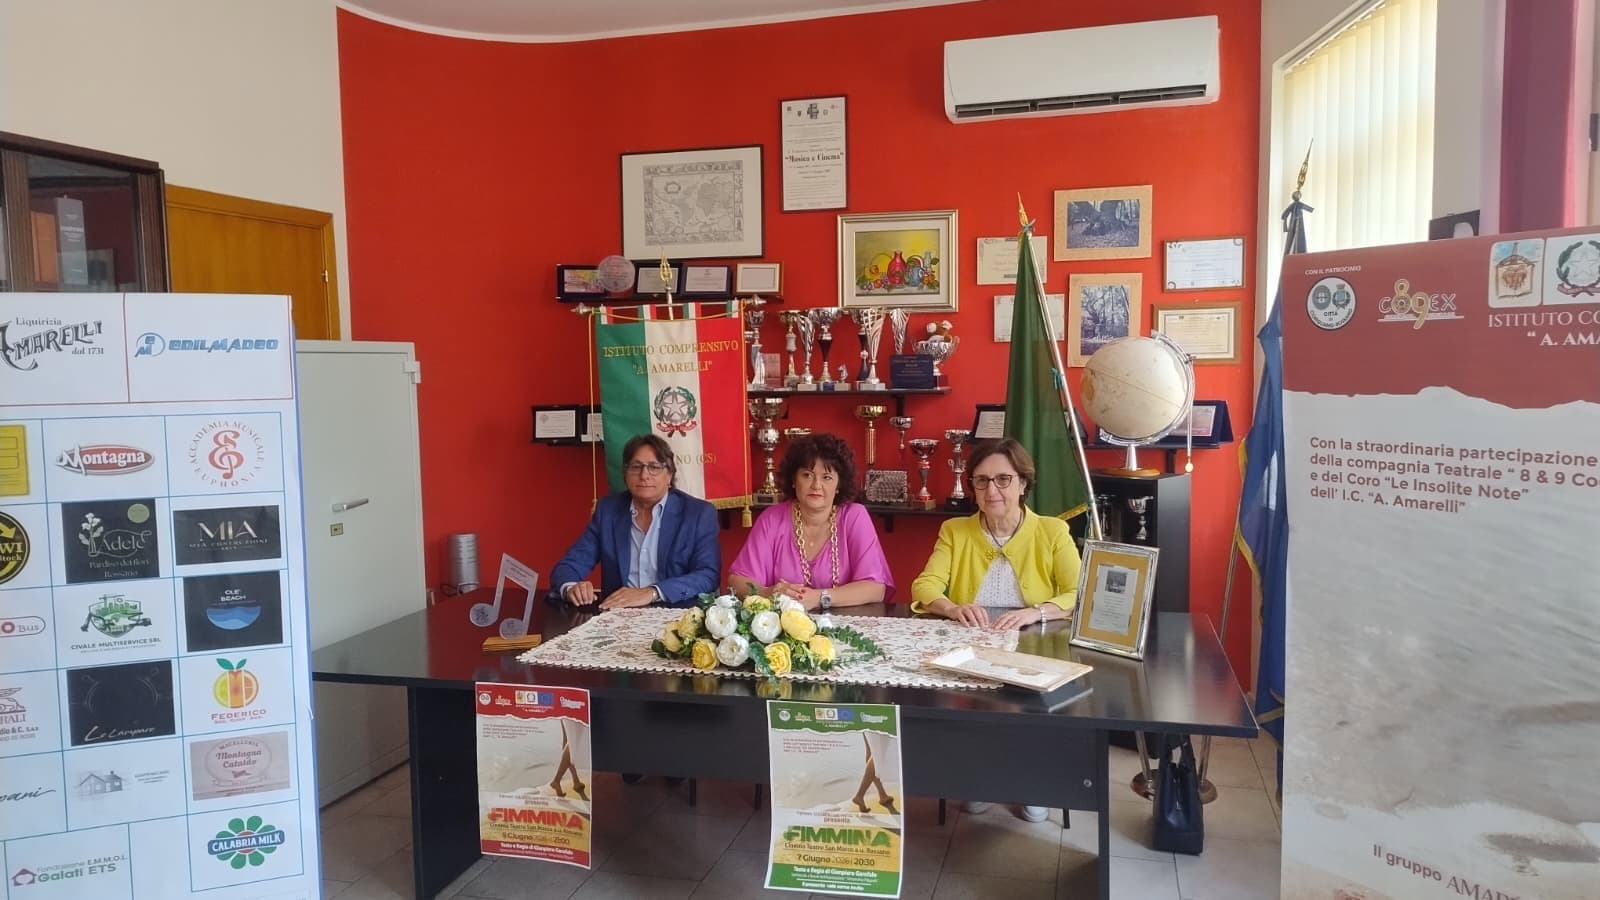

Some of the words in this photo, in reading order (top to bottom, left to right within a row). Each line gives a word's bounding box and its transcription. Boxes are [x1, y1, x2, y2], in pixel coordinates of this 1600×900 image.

[16, 316, 62, 326] Liquirizia
[1488, 312, 1572, 328] ISTITUTO
[1562, 332, 1600, 346] AM
[604, 344, 655, 358] ISTITUTO
[660, 340, 738, 354] COMPRENSIVO
[651, 360, 712, 374] AMARELLI"
[56, 441, 145, 476] Montagna
[1310, 437, 1336, 449] Con
[1340, 438, 1352, 450] la
[1356, 440, 1454, 457] straordinaria
[1460, 448, 1598, 467] partecipazione
[1310, 453, 1342, 466] della
[1347, 458, 1430, 474] compagnia
[1434, 462, 1502, 479] Teatrale
[1520, 469, 1530, 482] 8
[1536, 470, 1548, 484] &
[1554, 471, 1565, 485] 9
[1572, 473, 1600, 488] Co
[1310, 472, 1318, 480] e
[1322, 471, 1343, 483] del
[1347, 473, 1380, 487] Coro
[1385, 477, 1408, 489] "Le
[1414, 479, 1472, 496] Insolite
[1478, 485, 1529, 500] Note"
[1310, 486, 1338, 499] dell'
[1342, 490, 1364, 503] I.C.
[1368, 492, 1389, 505] "A.
[1393, 495, 1466, 513] Amarelli"
[198, 520, 257, 541] MIA
[98, 638, 147, 648] MULTISERVICE
[211, 709, 267, 720] FEDERICO
[216, 750, 262, 760] Montagna
[488, 808, 583, 830] FIMMINA
[212, 835, 257, 852] CALABRIA
[259, 831, 281, 844] MILK
[507, 832, 533, 841] Giugno
[783, 826, 890, 847] FIMMINA
[802, 854, 830, 864] Giugno
[1373, 844, 1381, 858] Il
[1386, 850, 1443, 882] gruppo
[38, 868, 83, 882] Galati
[88, 863, 116, 875] ETS
